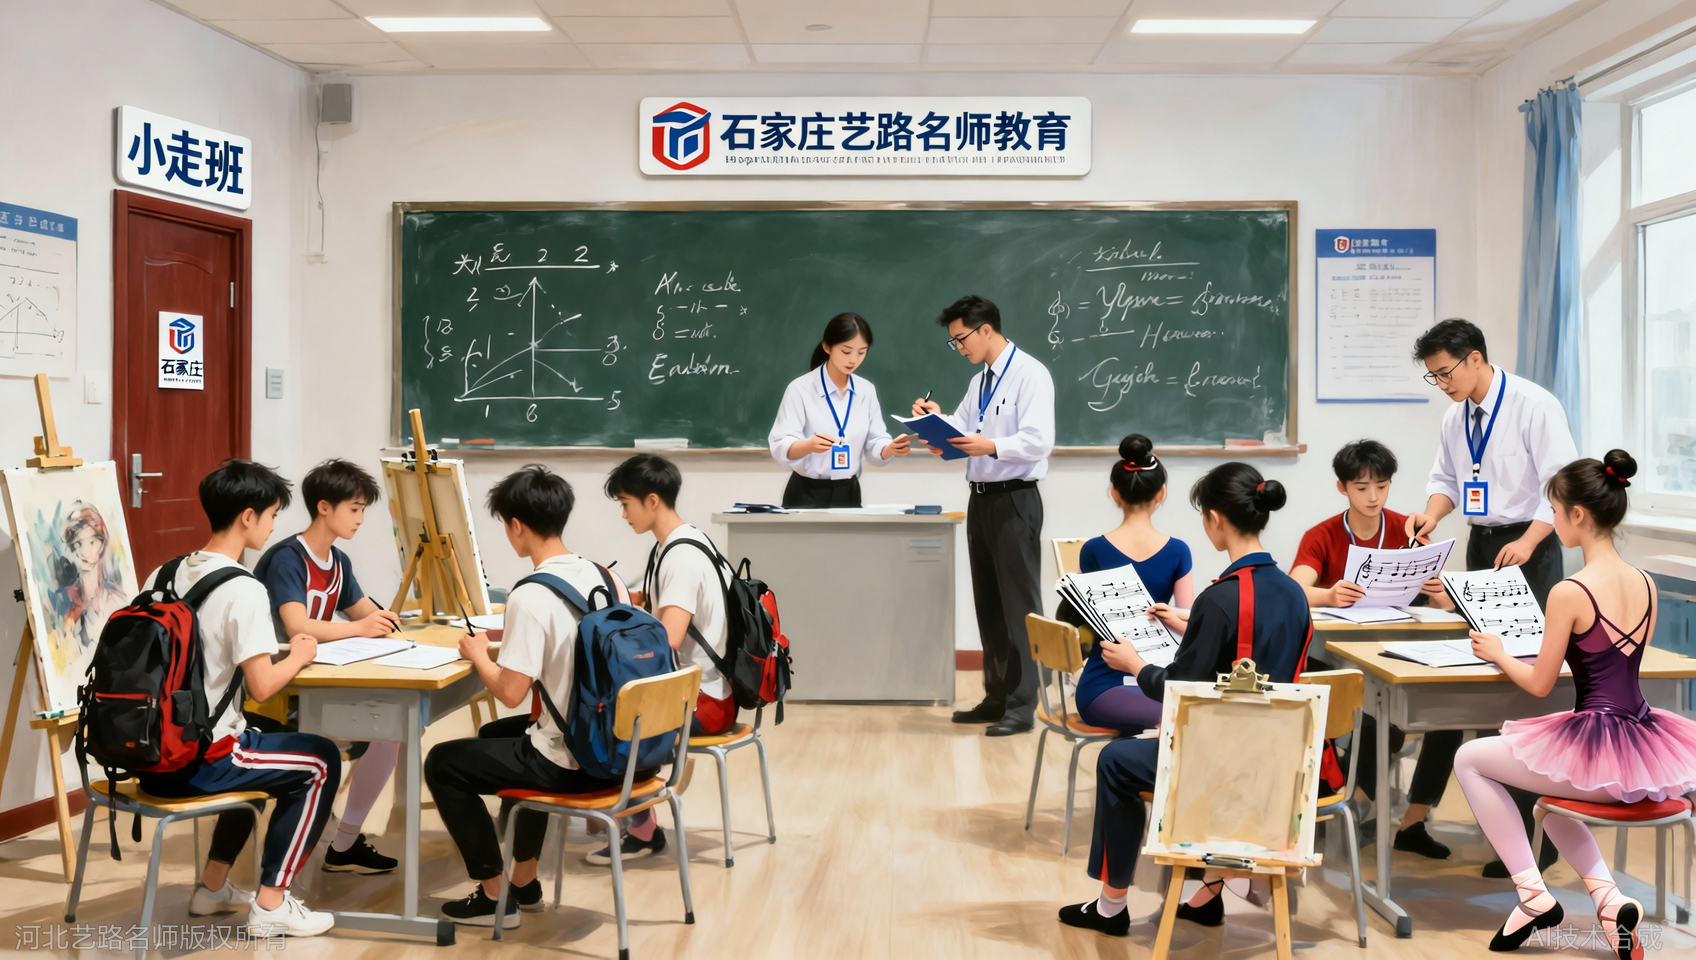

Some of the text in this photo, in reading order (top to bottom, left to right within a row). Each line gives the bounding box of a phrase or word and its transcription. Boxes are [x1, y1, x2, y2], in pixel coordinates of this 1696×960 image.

[127, 122, 244, 195] 小走班
[720, 111, 1072, 152] 石家庄艺路名师教育
